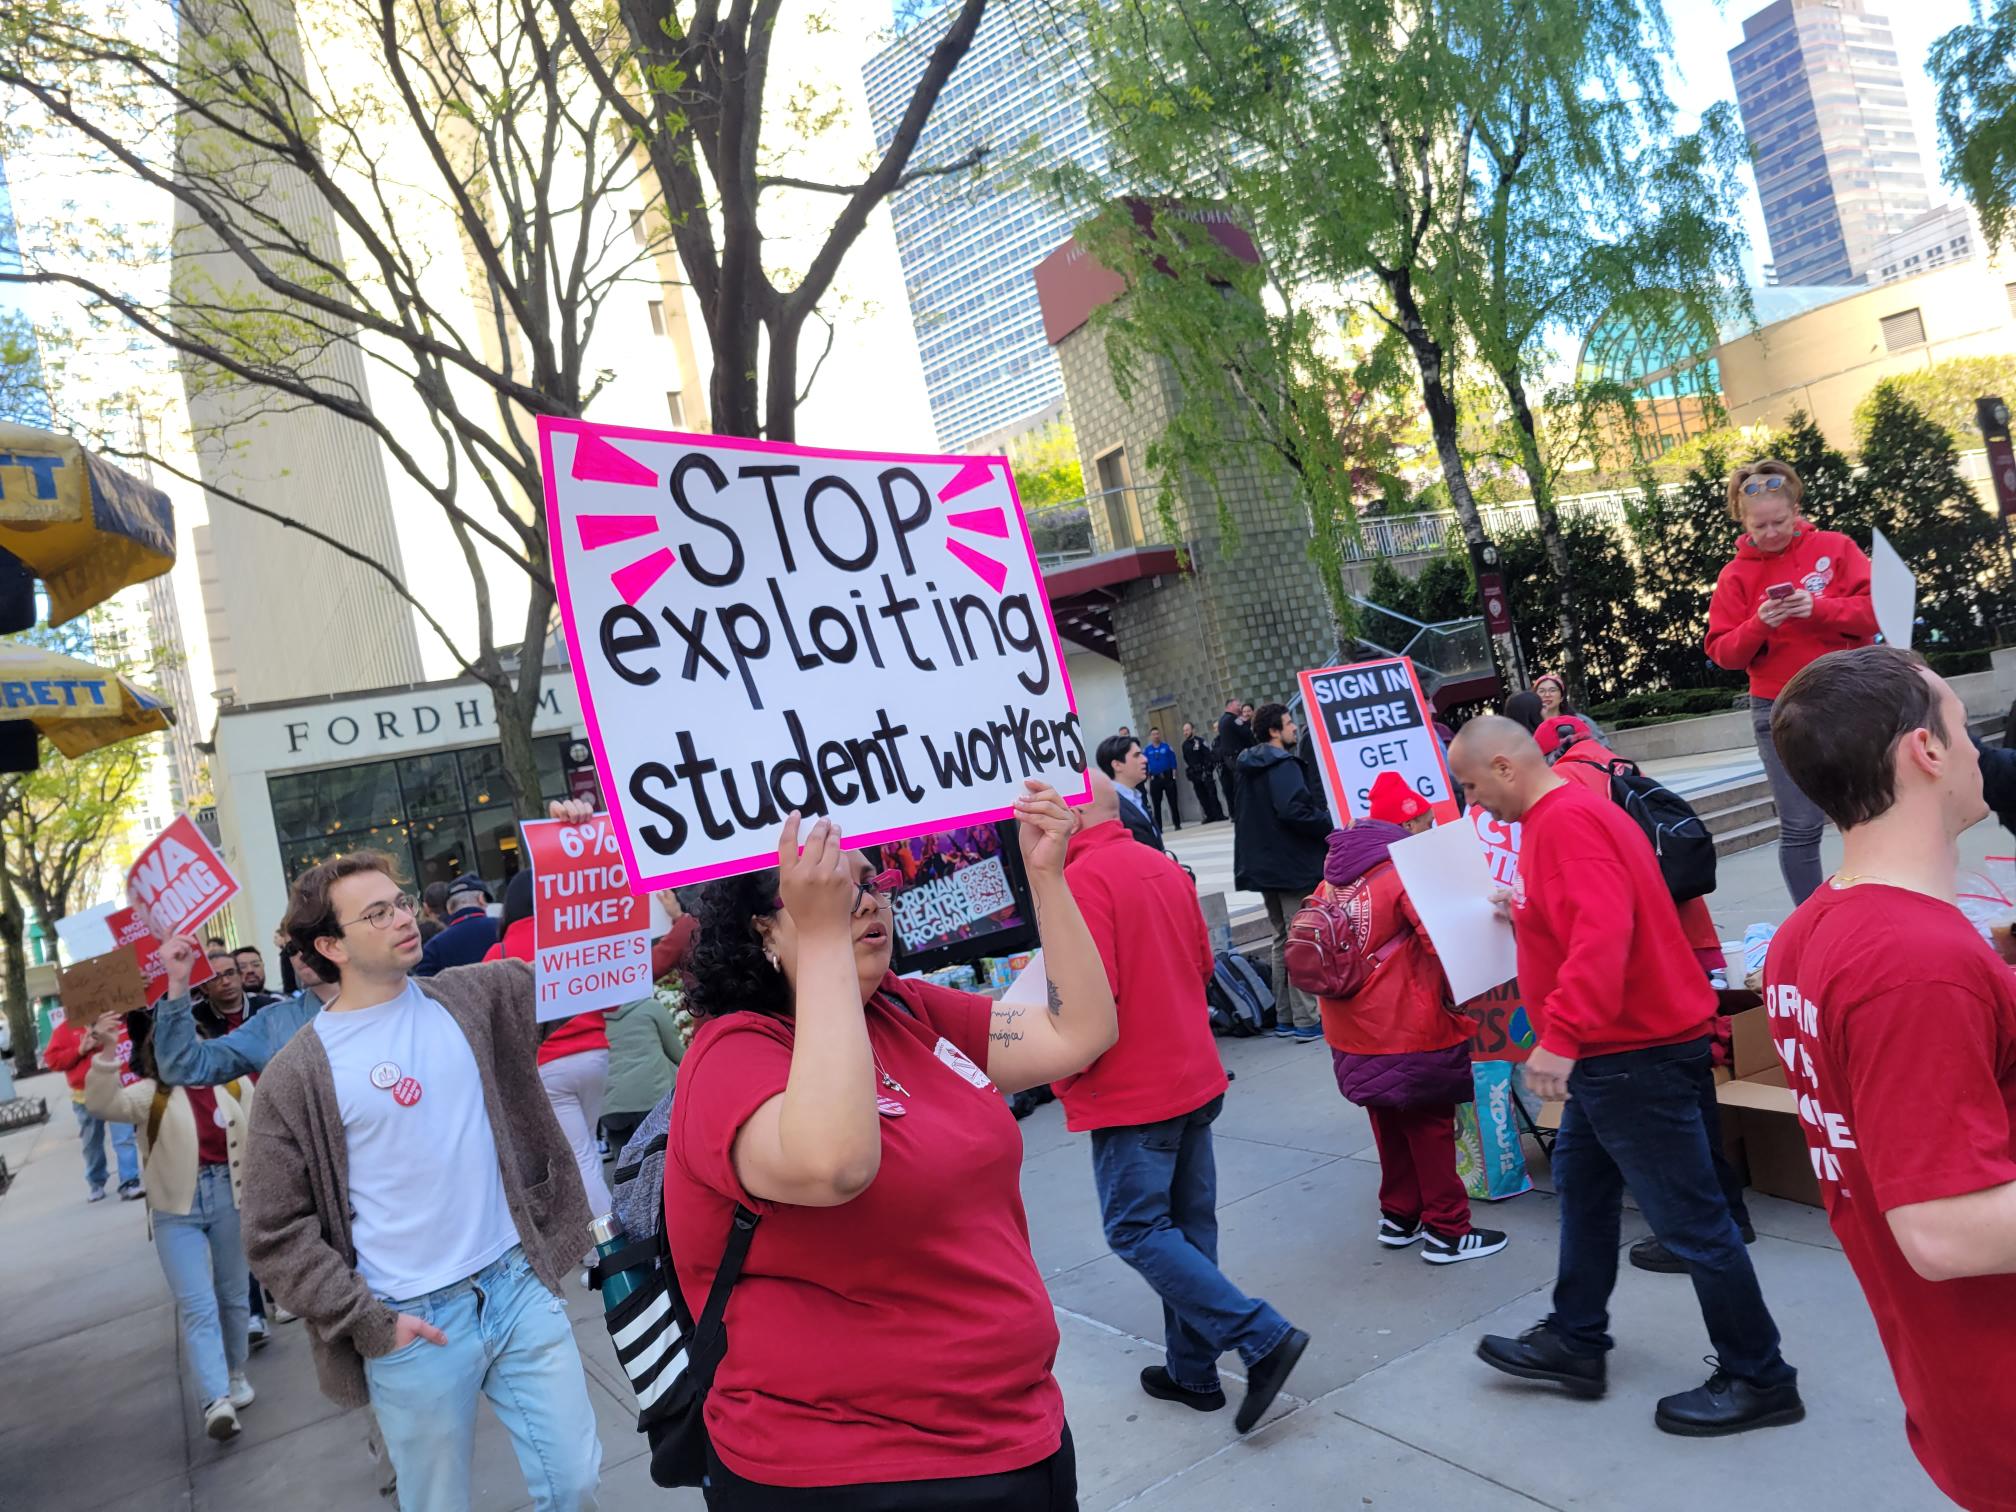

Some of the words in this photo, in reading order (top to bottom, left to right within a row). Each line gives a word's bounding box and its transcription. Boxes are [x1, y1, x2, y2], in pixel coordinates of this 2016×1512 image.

[669, 453, 932, 587] STOP
[600, 574, 1049, 711] exploiting
[0, 680, 106, 708] RETT
[1313, 672, 1380, 704] SIGN
[1381, 667, 1411, 693] IN
[285, 688, 562, 753] FORDHM
[1336, 701, 1411, 736] HERE
[1359, 739, 1408, 768] GET
[629, 709, 925, 856] student
[920, 705, 1087, 789] workers
[559, 822, 618, 858] 6%
[538, 864, 629, 899] TUITIO
[892, 876, 962, 912] ORDHAM
[554, 896, 635, 933] HIKE?
[902, 908, 974, 951] PROGRAM
[542, 937, 646, 973] WHERE'S
[541, 981, 560, 1002] IT
[567, 963, 648, 996] GOING?
[992, 1008, 1026, 1024] mujer
